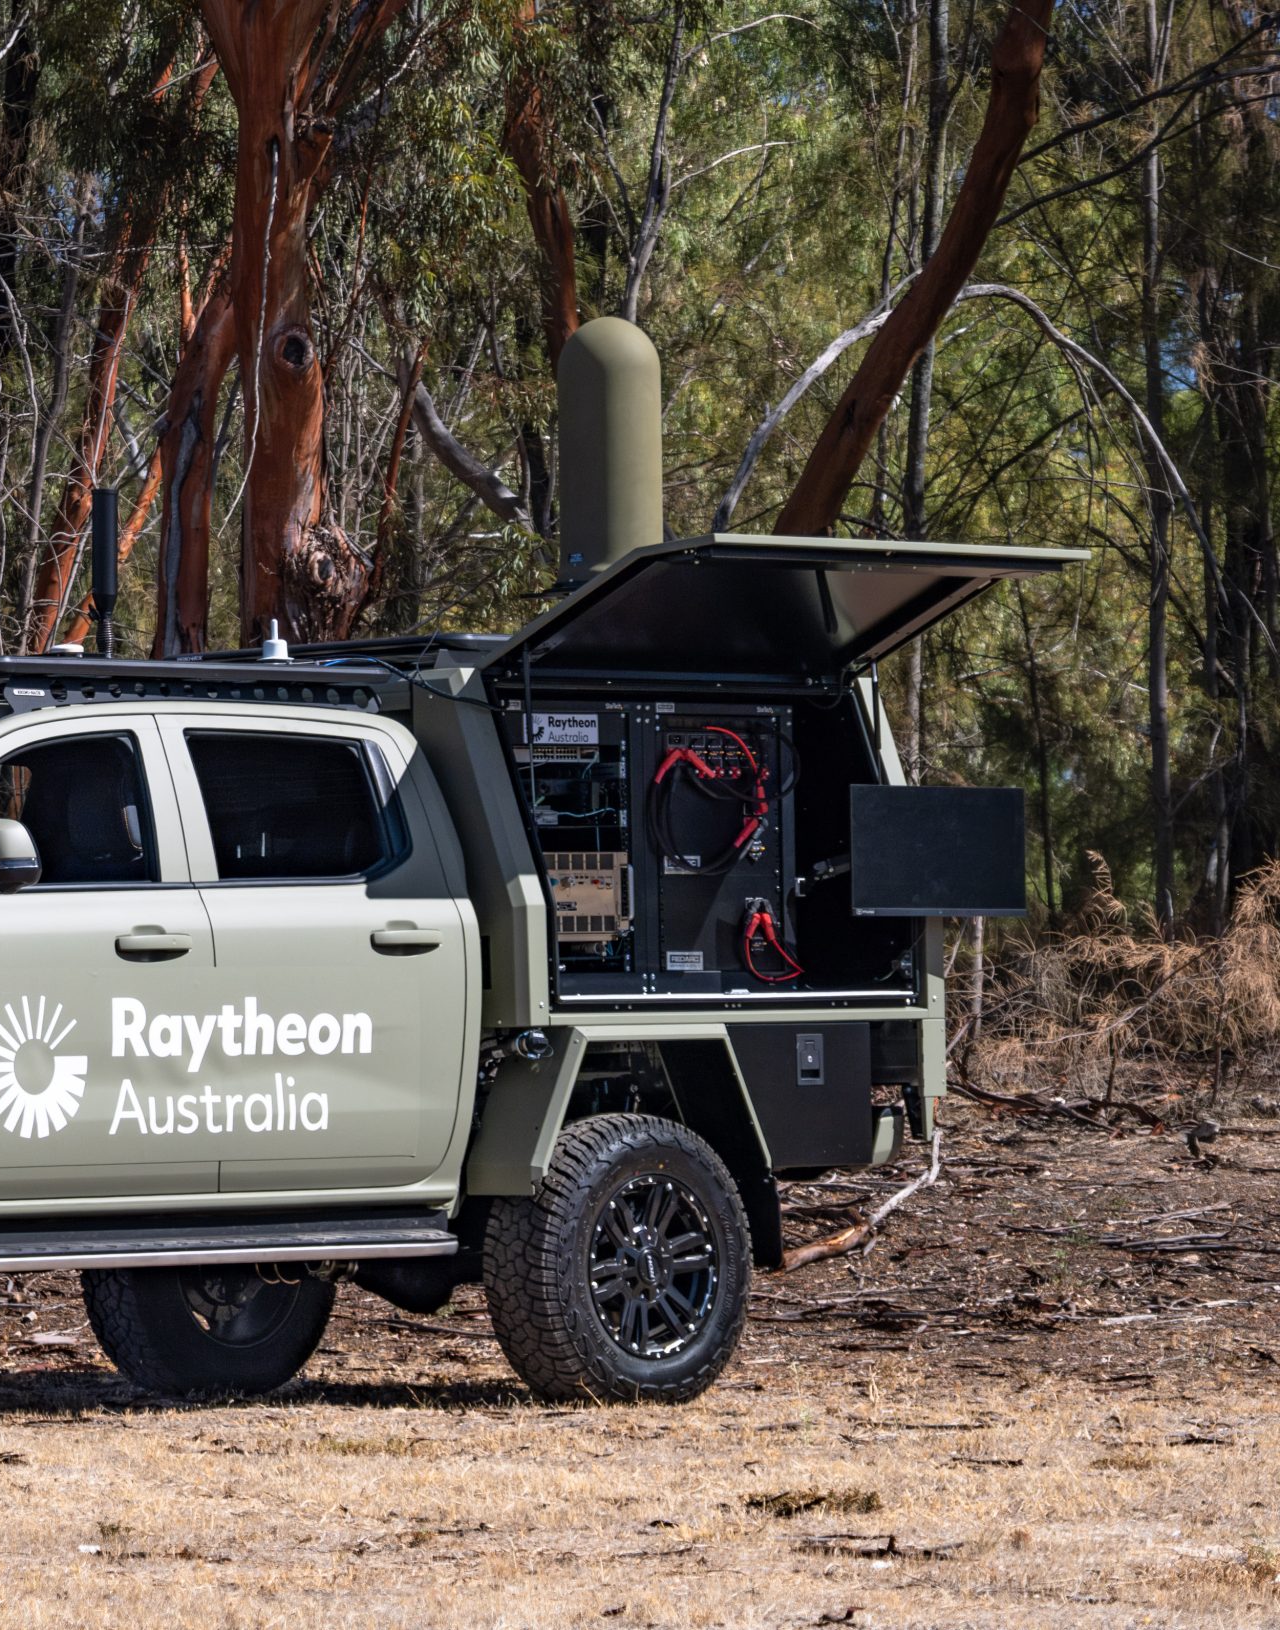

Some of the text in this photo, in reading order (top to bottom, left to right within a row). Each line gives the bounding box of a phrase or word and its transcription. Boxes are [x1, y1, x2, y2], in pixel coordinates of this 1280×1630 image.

[548, 716, 597, 730] Raytheon
[548, 732, 589, 743] Australia
[111, 996, 373, 1073] Raytheon
[108, 1072, 329, 1135] Australia
